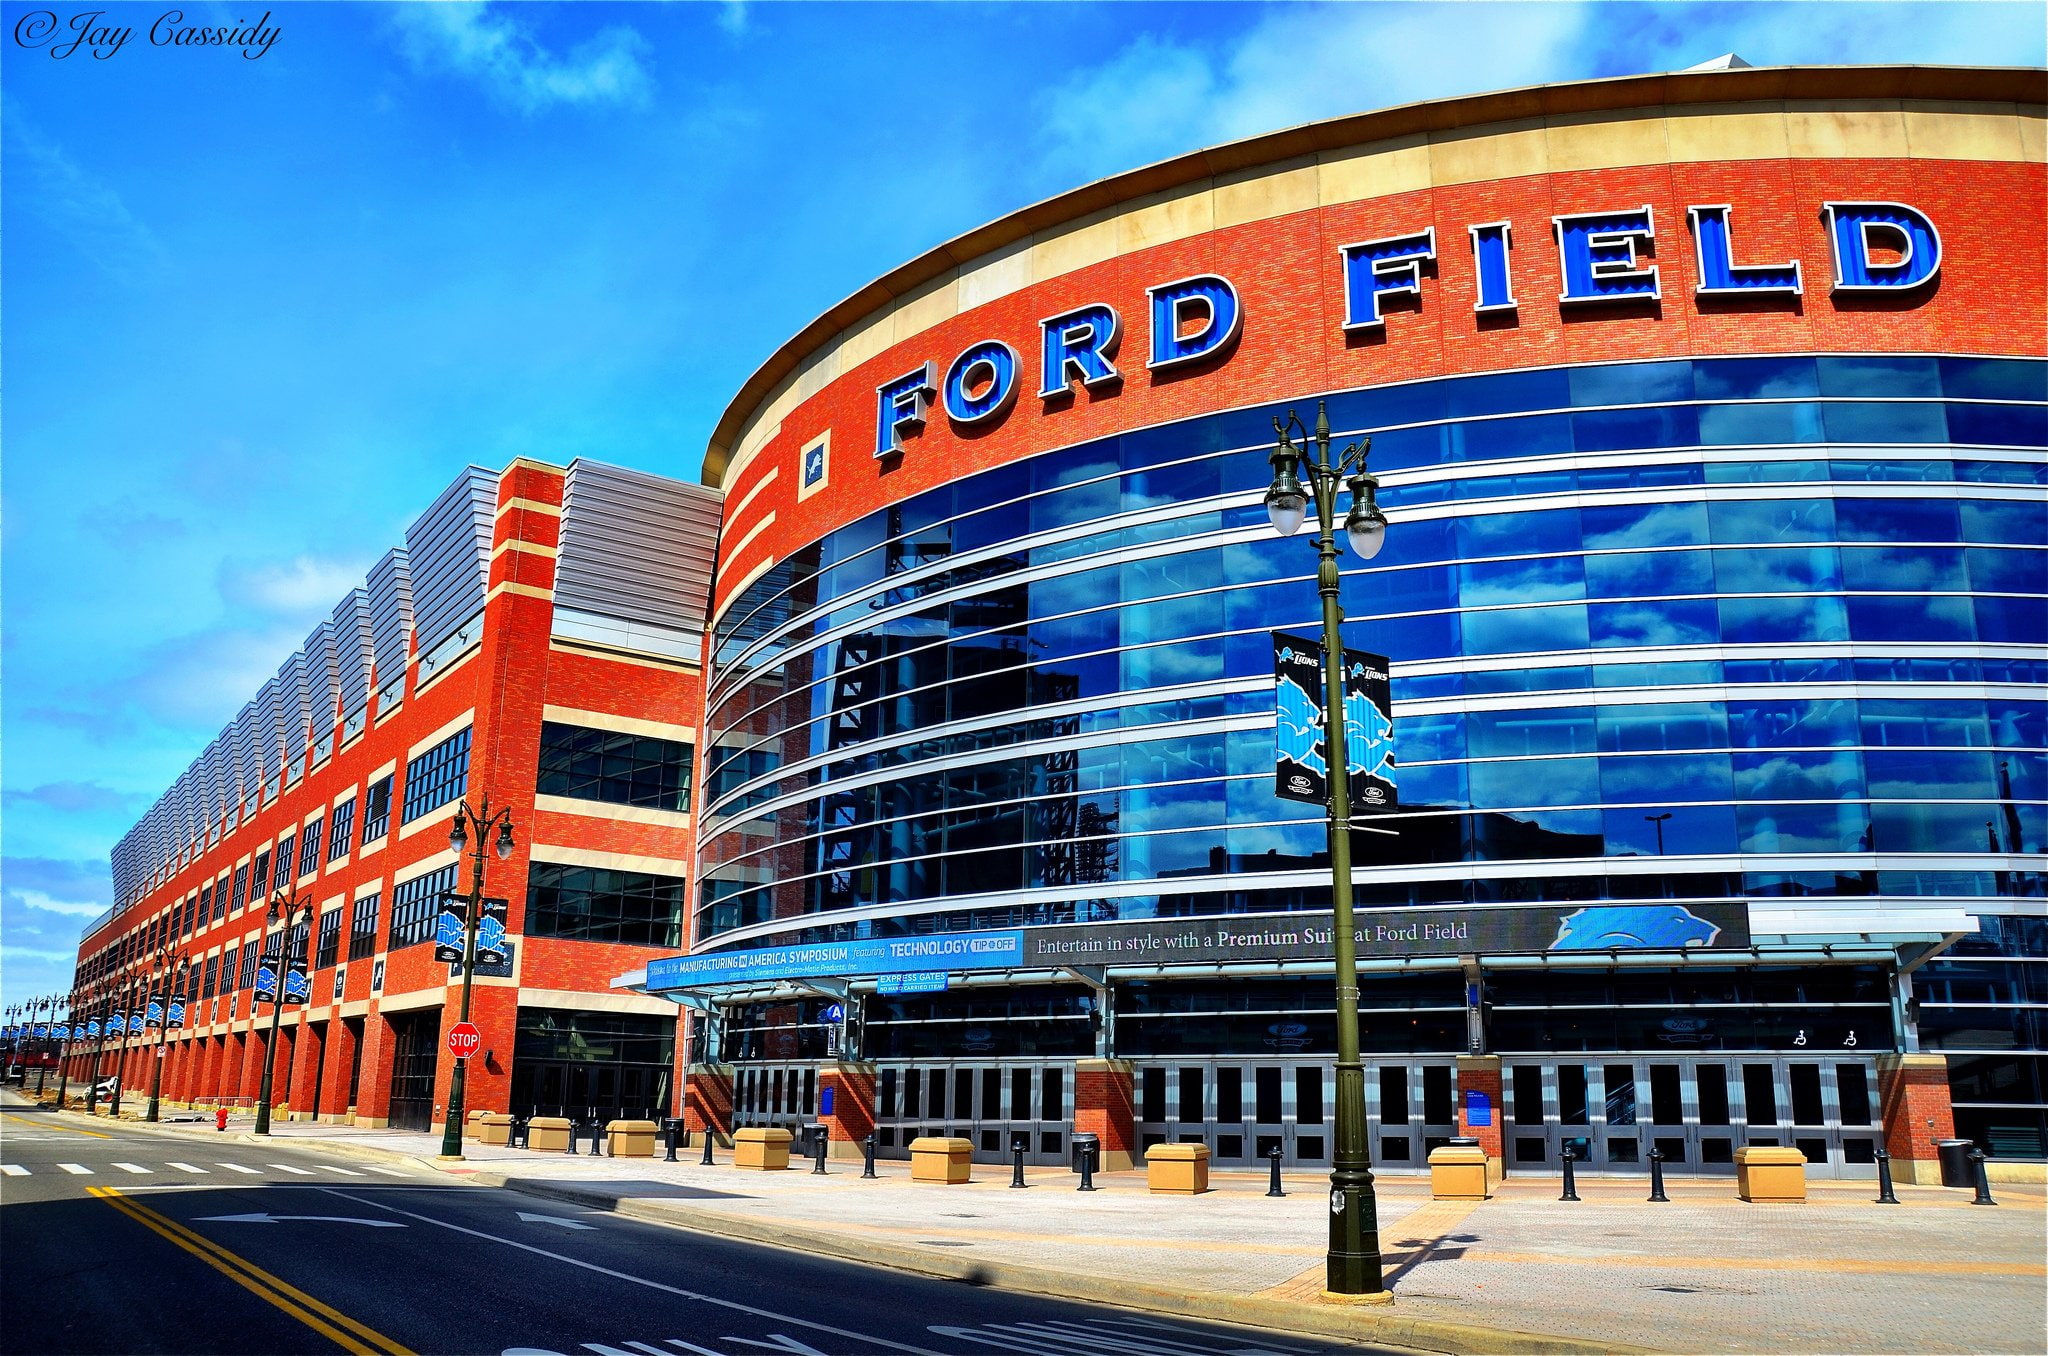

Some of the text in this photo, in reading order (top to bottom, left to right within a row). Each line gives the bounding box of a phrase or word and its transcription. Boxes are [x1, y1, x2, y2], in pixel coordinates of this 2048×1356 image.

[873, 201, 1943, 461] FORD FIELD
[1037, 937, 1102, 954] Entertain
[1107, 936, 1122, 951] in
[1126, 934, 1160, 954] style
[1164, 932, 1199, 949] with
[1203, 935, 1213, 947] a
[1217, 930, 1298, 947] Premium
[1354, 926, 1371, 941] at
[1376, 923, 1418, 942] Ford
[1424, 922, 1467, 940] Field
[680, 957, 738, 974] MANUFACTURING
[748, 951, 787, 967] AMERICA
[789, 947, 848, 963] SYMPOSIUM
[853, 946, 886, 959] featuring
[889, 938, 970, 957] TECHNOLOGY
[974, 940, 988, 951] TIP
[996, 939, 1014, 950] OFF
[880, 972, 945, 983] EXPRESS GATES
[832, 1006, 842, 1018] A
[449, 1033, 478, 1047] STOP
